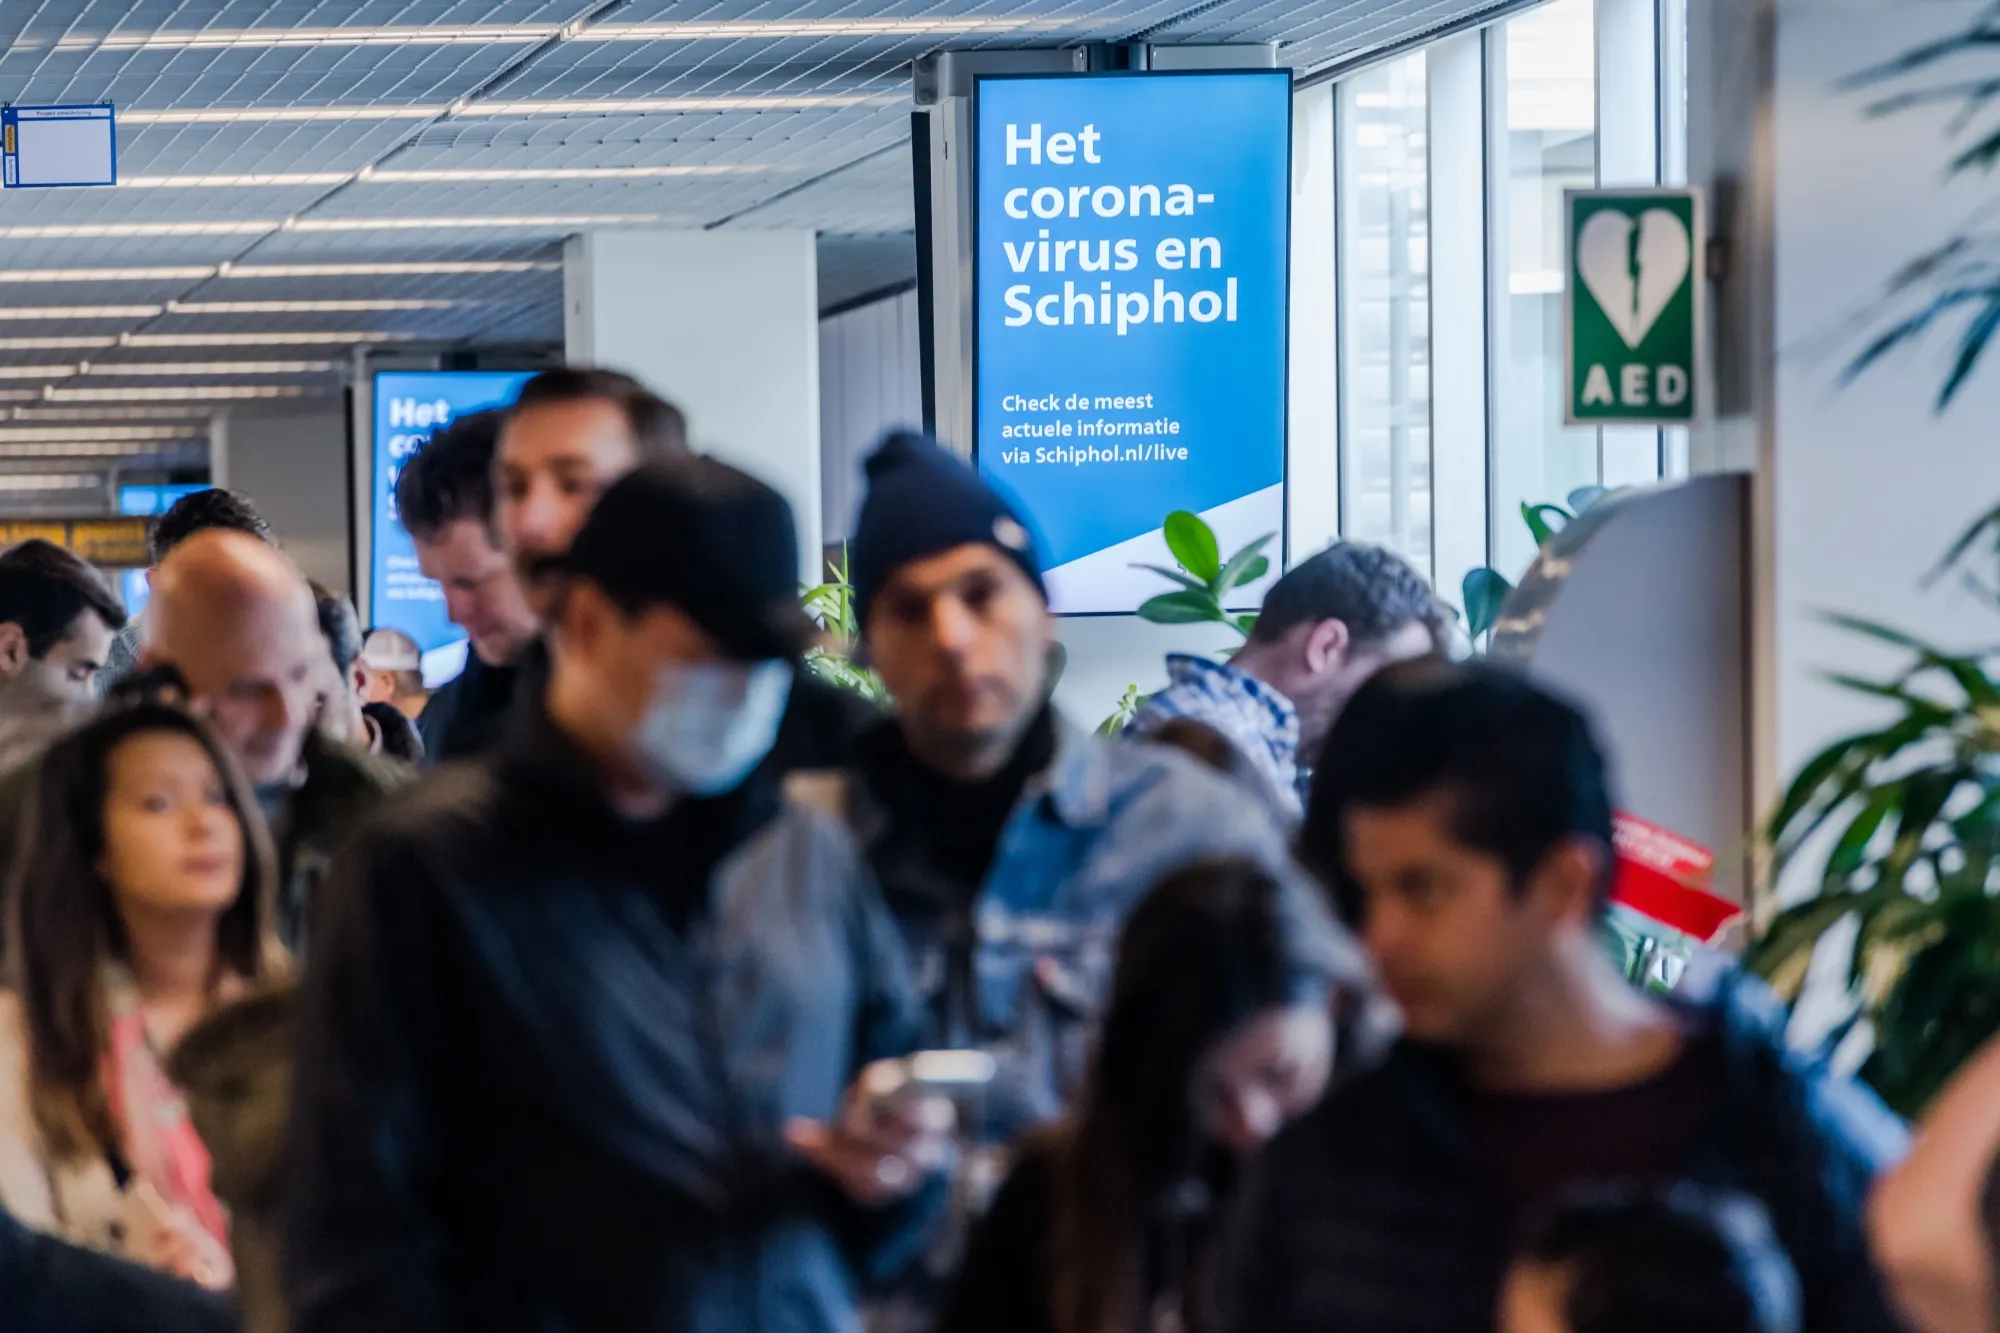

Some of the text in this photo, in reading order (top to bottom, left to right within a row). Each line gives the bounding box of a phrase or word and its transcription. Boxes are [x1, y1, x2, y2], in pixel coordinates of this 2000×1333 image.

[1005, 123, 1101, 165] Het
[1003, 183, 1214, 219] corona-
[1003, 229, 1221, 272] virus en
[1004, 276, 1237, 336] Schiphol
[1002, 393, 1153, 411] Check de meest
[1581, 362, 1688, 406] AED
[387, 397, 450, 428] Het
[1002, 418, 1180, 438] actuele informatie
[1002, 444, 1188, 467] via Schiphol.nl/live
